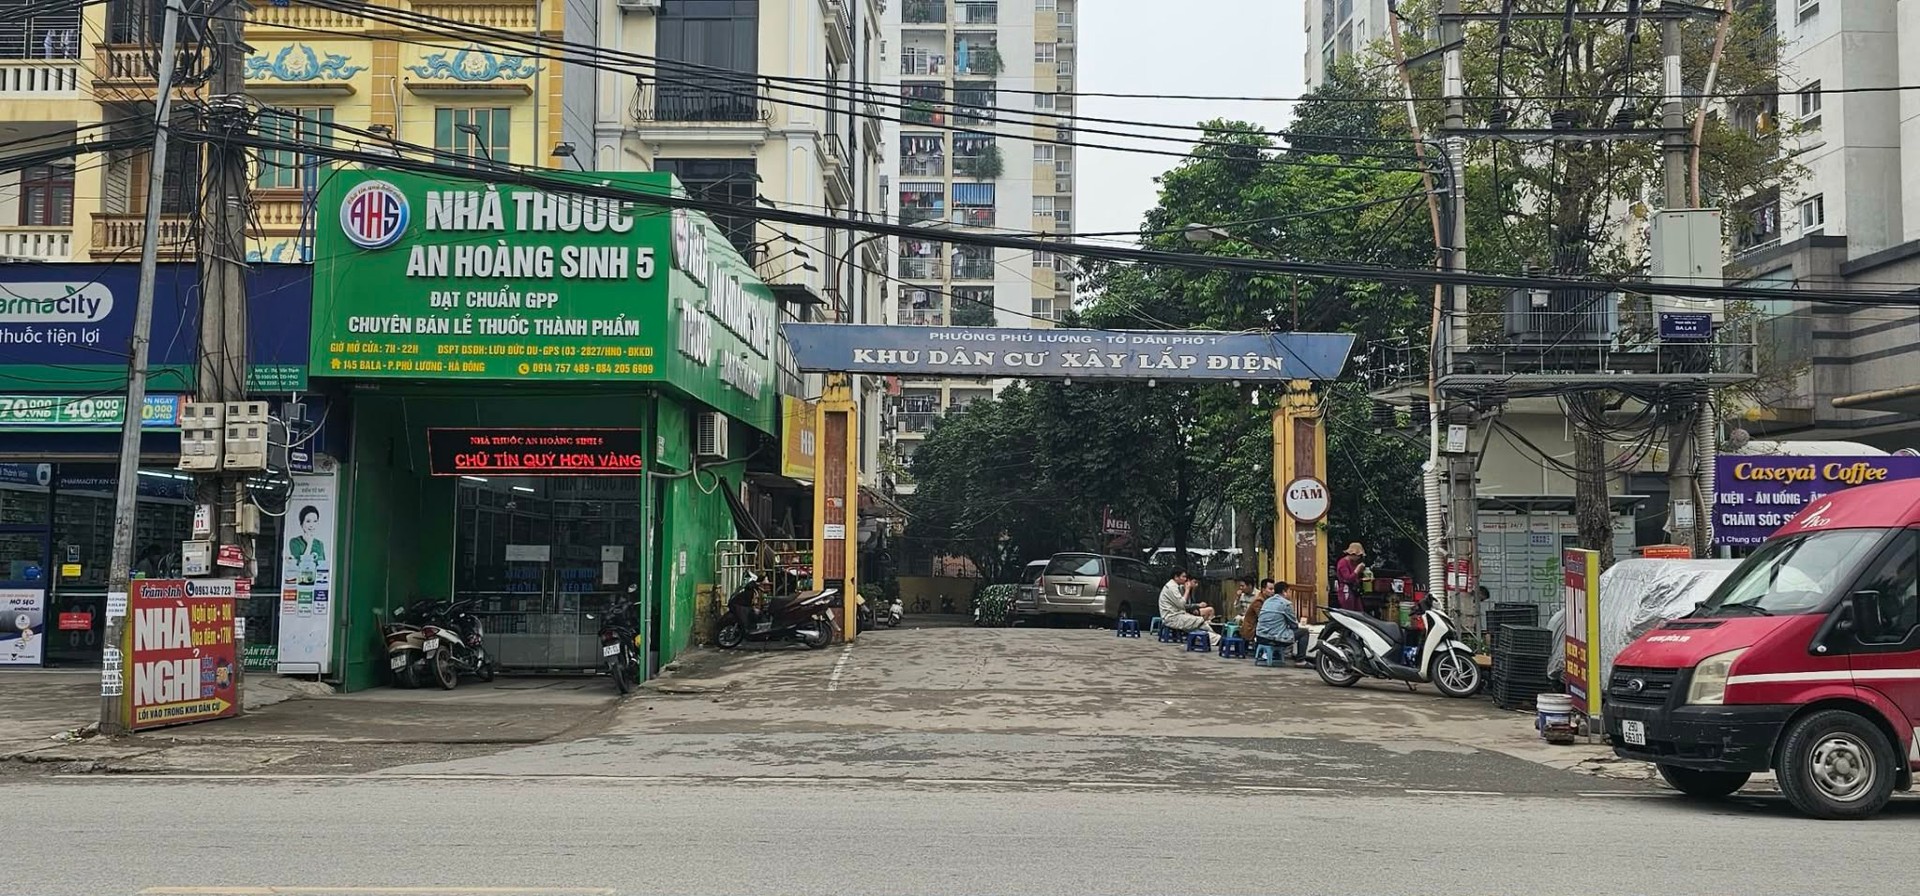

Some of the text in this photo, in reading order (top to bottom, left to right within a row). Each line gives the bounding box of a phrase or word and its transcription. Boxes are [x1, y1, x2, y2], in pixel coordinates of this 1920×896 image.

[350, 191, 399, 239] AHS
[426, 180, 635, 233] NHÀ THUỐC
[406, 240, 654, 279] AN HOÀNG SINH 5
[430, 285, 559, 310] ĐẠT CHUẨN GPP
[349, 312, 640, 336] CHUYÊN BÁN LẺ THUỐC THÀNH PHẨM
[47, 328, 77, 346] tiện
[82, 328, 100, 346] lợi
[929, 330, 996, 342] PHƯỜNG
[1001, 331, 1033, 343] PHÚ
[1038, 333, 1092, 344] LƯƠNG
[1105, 331, 1126, 344] TỔ
[1132, 333, 1167, 345] DÂN
[1172, 333, 1204, 345] PHỐ
[853, 345, 1284, 373] KHU DÂN CƯ XÂY LẮP ĐIỆN
[29, 400, 52, 409] 000
[64, 400, 95, 418] 40
[95, 400, 119, 409] 000
[470, 435, 490, 445] NHÀ
[492, 436, 524, 445] THUỐC
[525, 437, 538, 445] AN
[539, 435, 573, 445] HOÀNG
[575, 437, 597, 446] SINH
[455, 450, 642, 468] CHỮ TÍN QUÝ HƠN VÀNG
[1823, 463, 1888, 484] Coffee
[1290, 485, 1323, 500] CẤM
[1721, 491, 1744, 506] KIỆN
[1772, 489, 1800, 504] UỐNG
[1722, 511, 1756, 526] CHĂM
[1758, 511, 1781, 526] SÓC
[1726, 536, 1749, 544] Chung
[134, 600, 192, 652] NHÀ
[134, 648, 201, 706] NGHỈ
[150, 707, 163, 718] VÀO
[164, 705, 184, 717] TRONG
[185, 704, 198, 714] KHU
